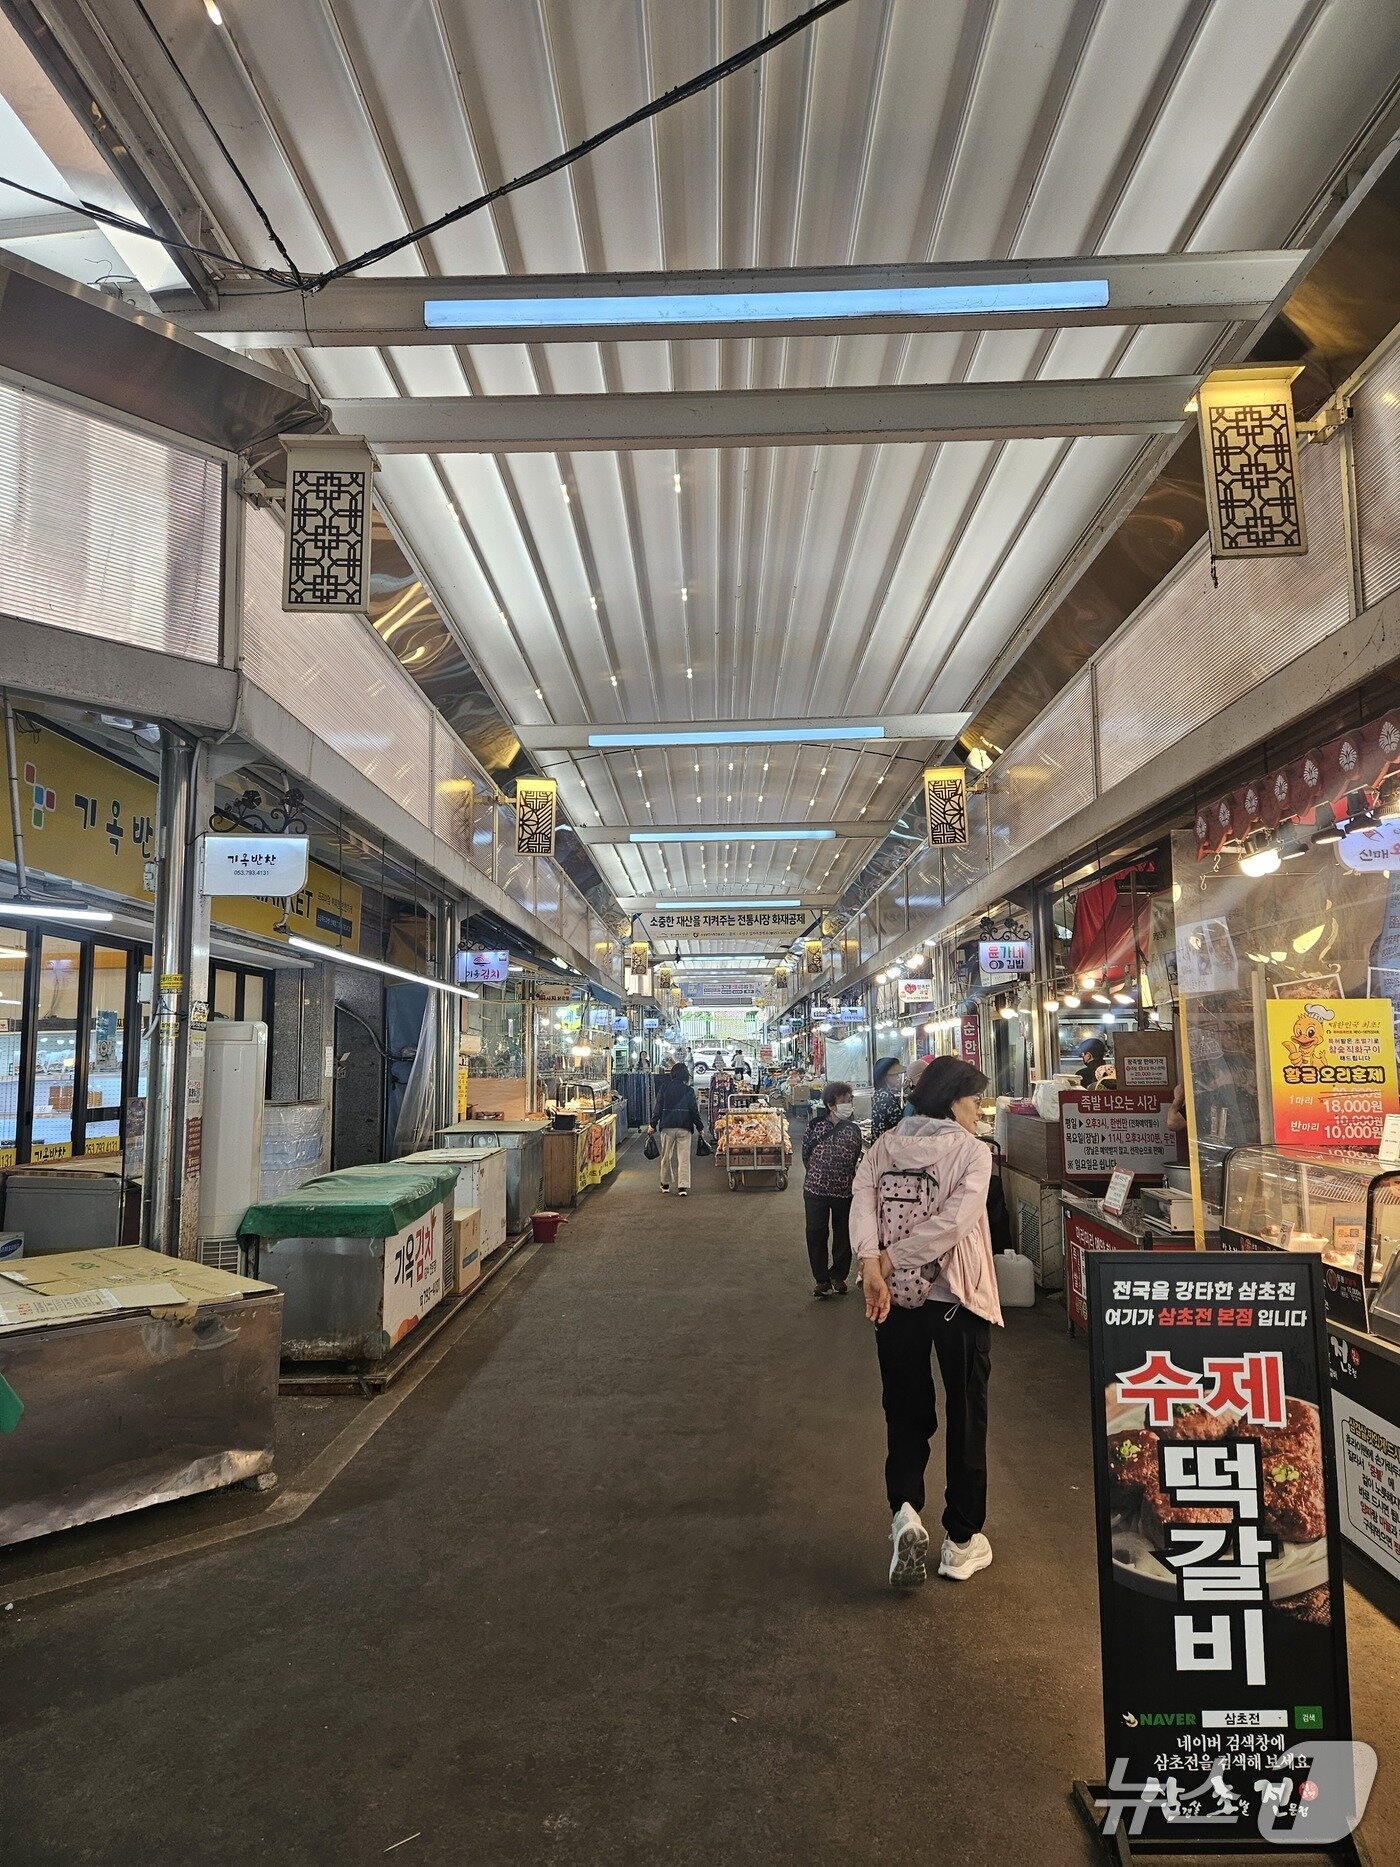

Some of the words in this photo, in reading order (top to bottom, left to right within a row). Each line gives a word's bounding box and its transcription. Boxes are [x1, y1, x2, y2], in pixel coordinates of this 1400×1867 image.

[227, 853, 277, 867] 기옥반찬
[650, 916, 675, 928] 소중한
[676, 915, 701, 928] 재산을
[703, 915, 735, 927] 지켜주는
[738, 914, 770, 926] 전통시장
[772, 913, 806, 925] 화재공제
[1006, 960, 1024, 970] 김밥
[1283, 1066, 1318, 1084] 황금
[1319, 1066, 1385, 1083] 오리훈제
[1081, 1095, 1101, 1111] 족발
[1104, 1095, 1134, 1111] 나오는
[1137, 1095, 1158, 1111] 시간
[1289, 1095, 1313, 1106] 1마리
[1323, 1100, 1384, 1113] 18,000원
[1291, 1121, 1319, 1132] 반마리
[1325, 1126, 1383, 1139] 10,000원
[1075, 1159, 1100, 1171] 일요일은
[1112, 1280, 1170, 1301] 전국을
[1175, 1280, 1234, 1301] 강타한
[1238, 1281, 1297, 1301] 삼초전
[1105, 1308, 1155, 1326] 여기가
[1158, 1308, 1213, 1327] 삼초전
[1217, 1308, 1253, 1327] 본점
[1257, 1309, 1308, 1327] 입니다
[1115, 1350, 1287, 1429] 수제
[1164, 1443, 1273, 1686] 떡갈비
[1140, 1713, 1197, 1727] NAVER
[1224, 1713, 1261, 1726] 삼초전
[1302, 1713, 1316, 1722] 검색
[1177, 1734, 1221, 1752] 네이버
[1226, 1734, 1286, 1752] 검색창에
[1154, 1754, 1214, 1772] 삼초전을
[1217, 1753, 1263, 1772] 검색해
[1264, 1754, 1311, 1771] 보세요
